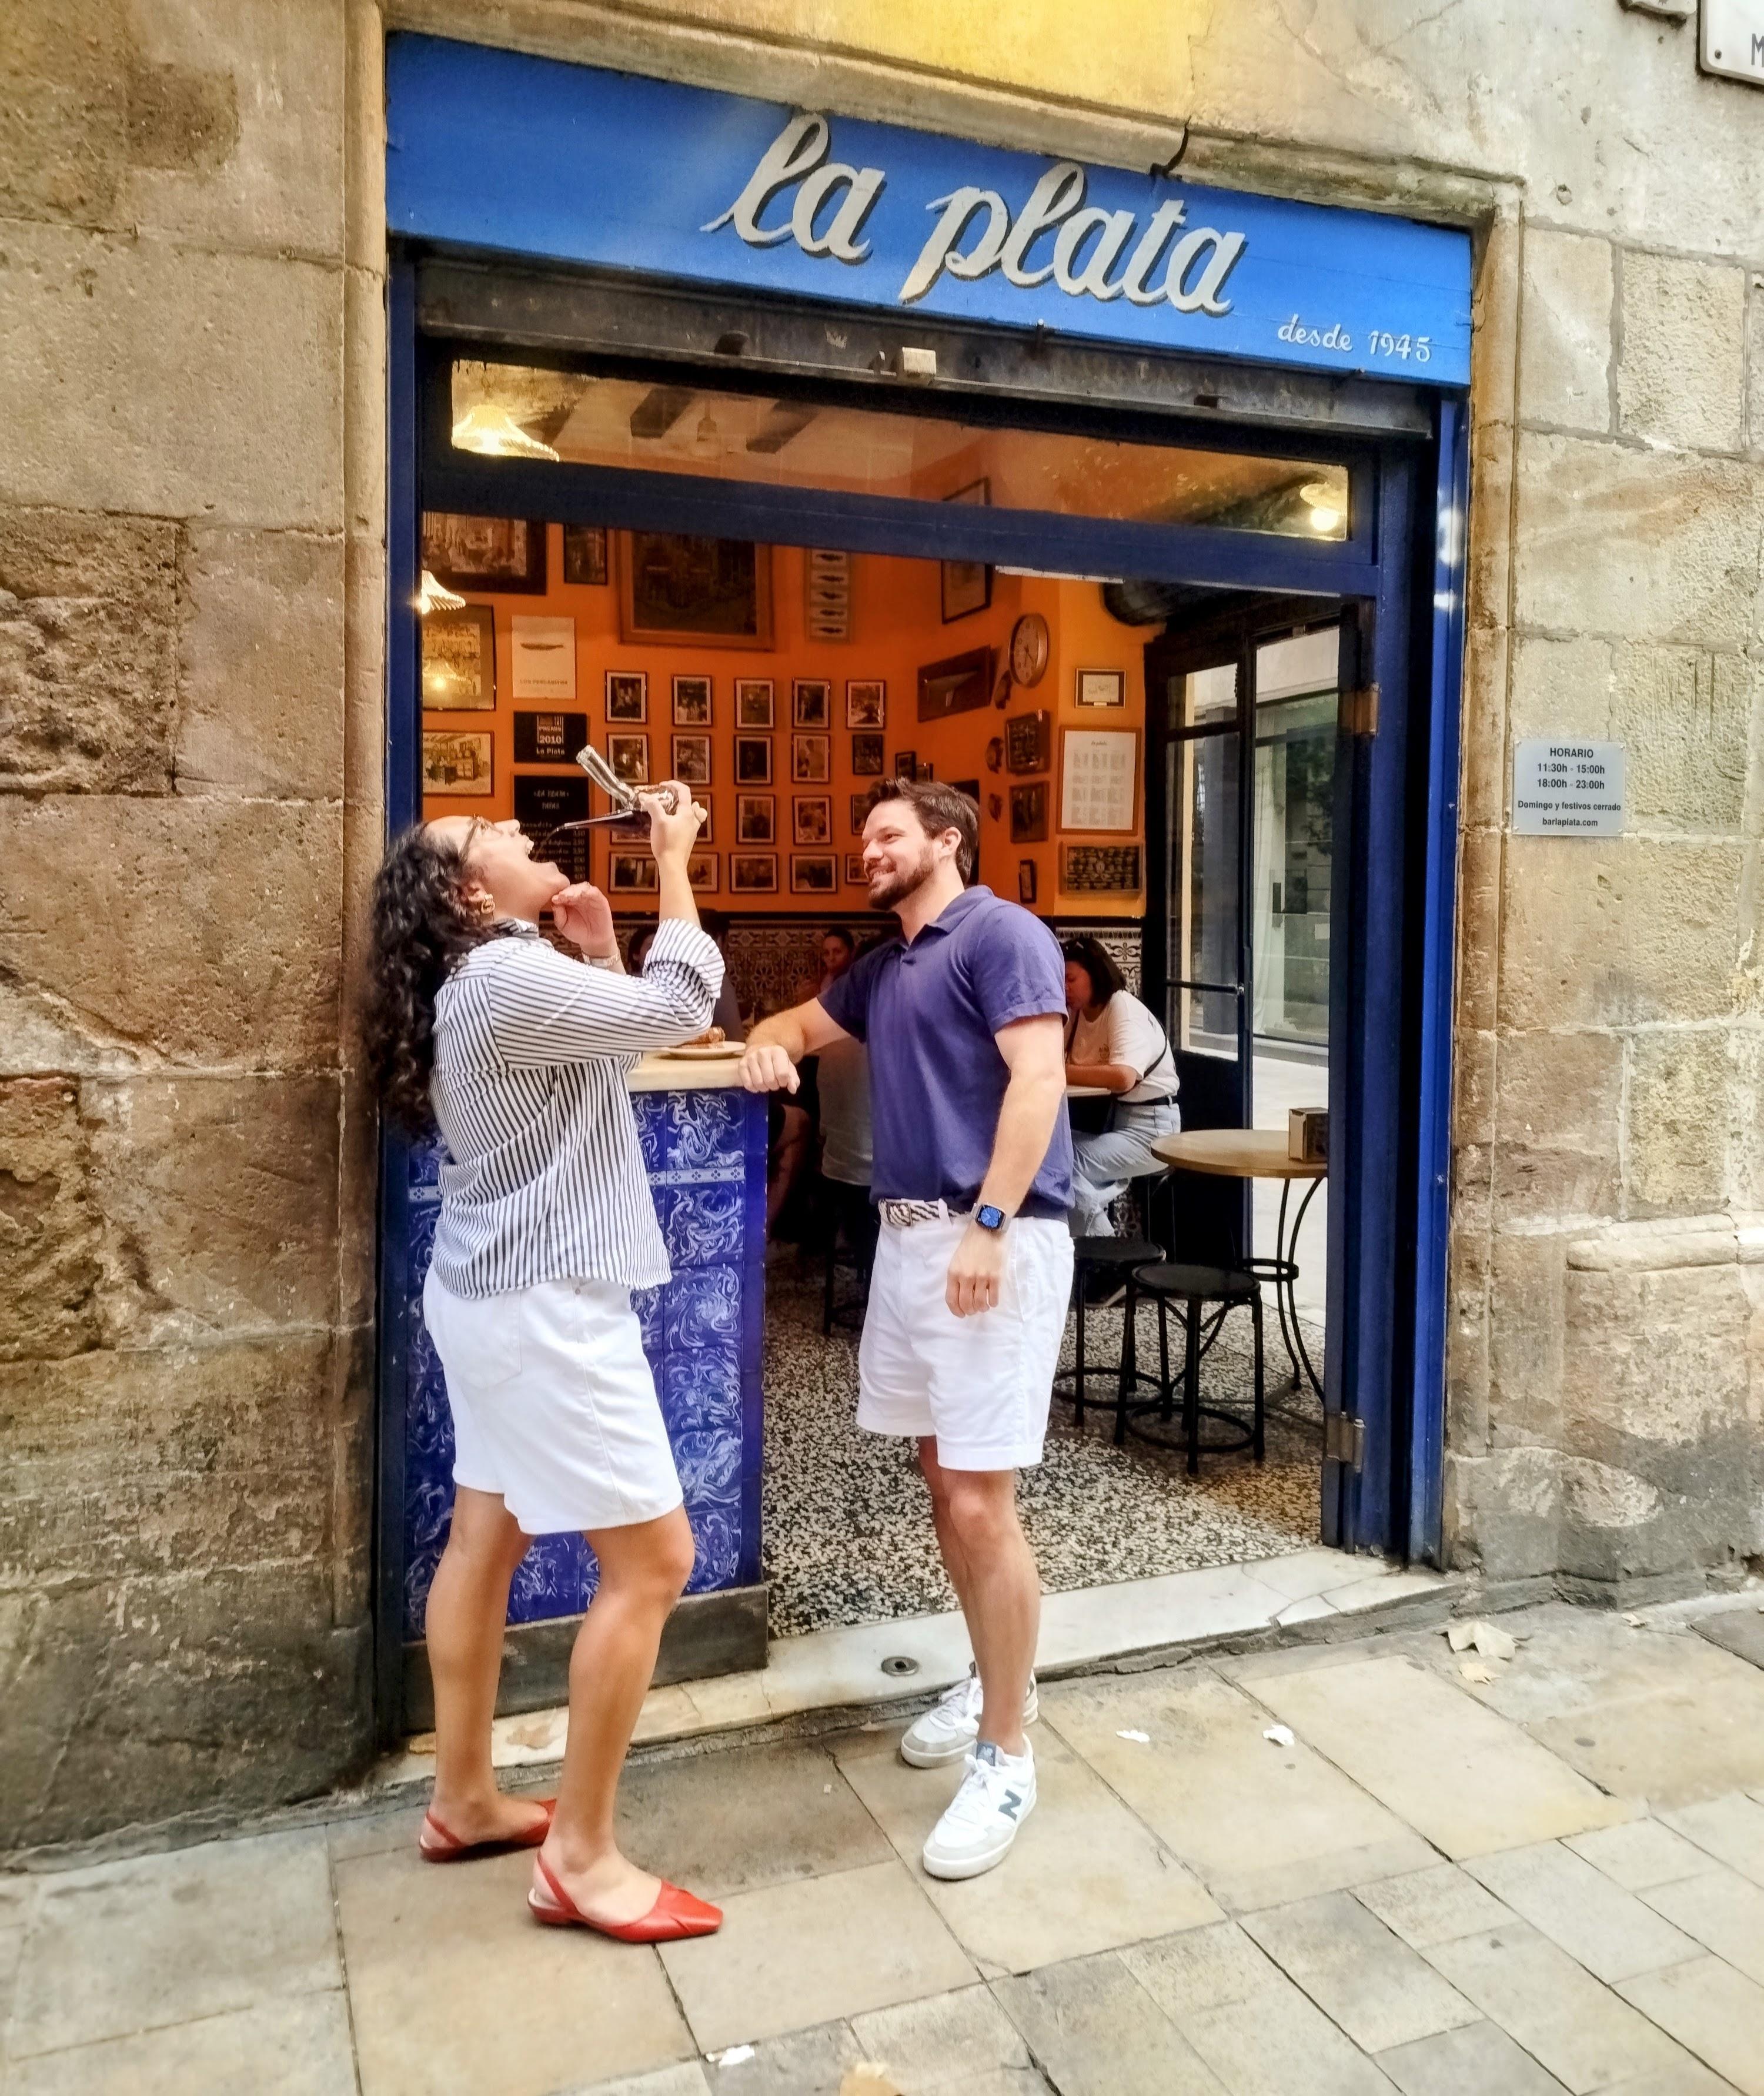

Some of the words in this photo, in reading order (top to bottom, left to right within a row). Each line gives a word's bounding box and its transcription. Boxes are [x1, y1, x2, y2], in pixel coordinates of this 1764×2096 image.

[700, 115, 884, 259] la
[900, 162, 1245, 313] plata
[1277, 313, 1353, 351] desde
[1368, 330, 1431, 362] 1945
[539, 735, 562, 744] 2010
[536, 747, 544, 755] La
[547, 747, 565, 756] Plata
[1550, 748, 1593, 758] HORARIO
[1538, 763, 1568, 773] 11:30h
[1576, 765, 1605, 774] 15:00h
[1537, 778, 1567, 788] 18:00h
[1576, 780, 1605, 789] 23:00h
[1518, 800, 1553, 811] Domingo
[1555, 803, 1559, 811] y
[1562, 801, 1591, 810] festivos
[1593, 803, 1621, 811] cerrado
[1542, 817, 1598, 827] barlaplata.com
